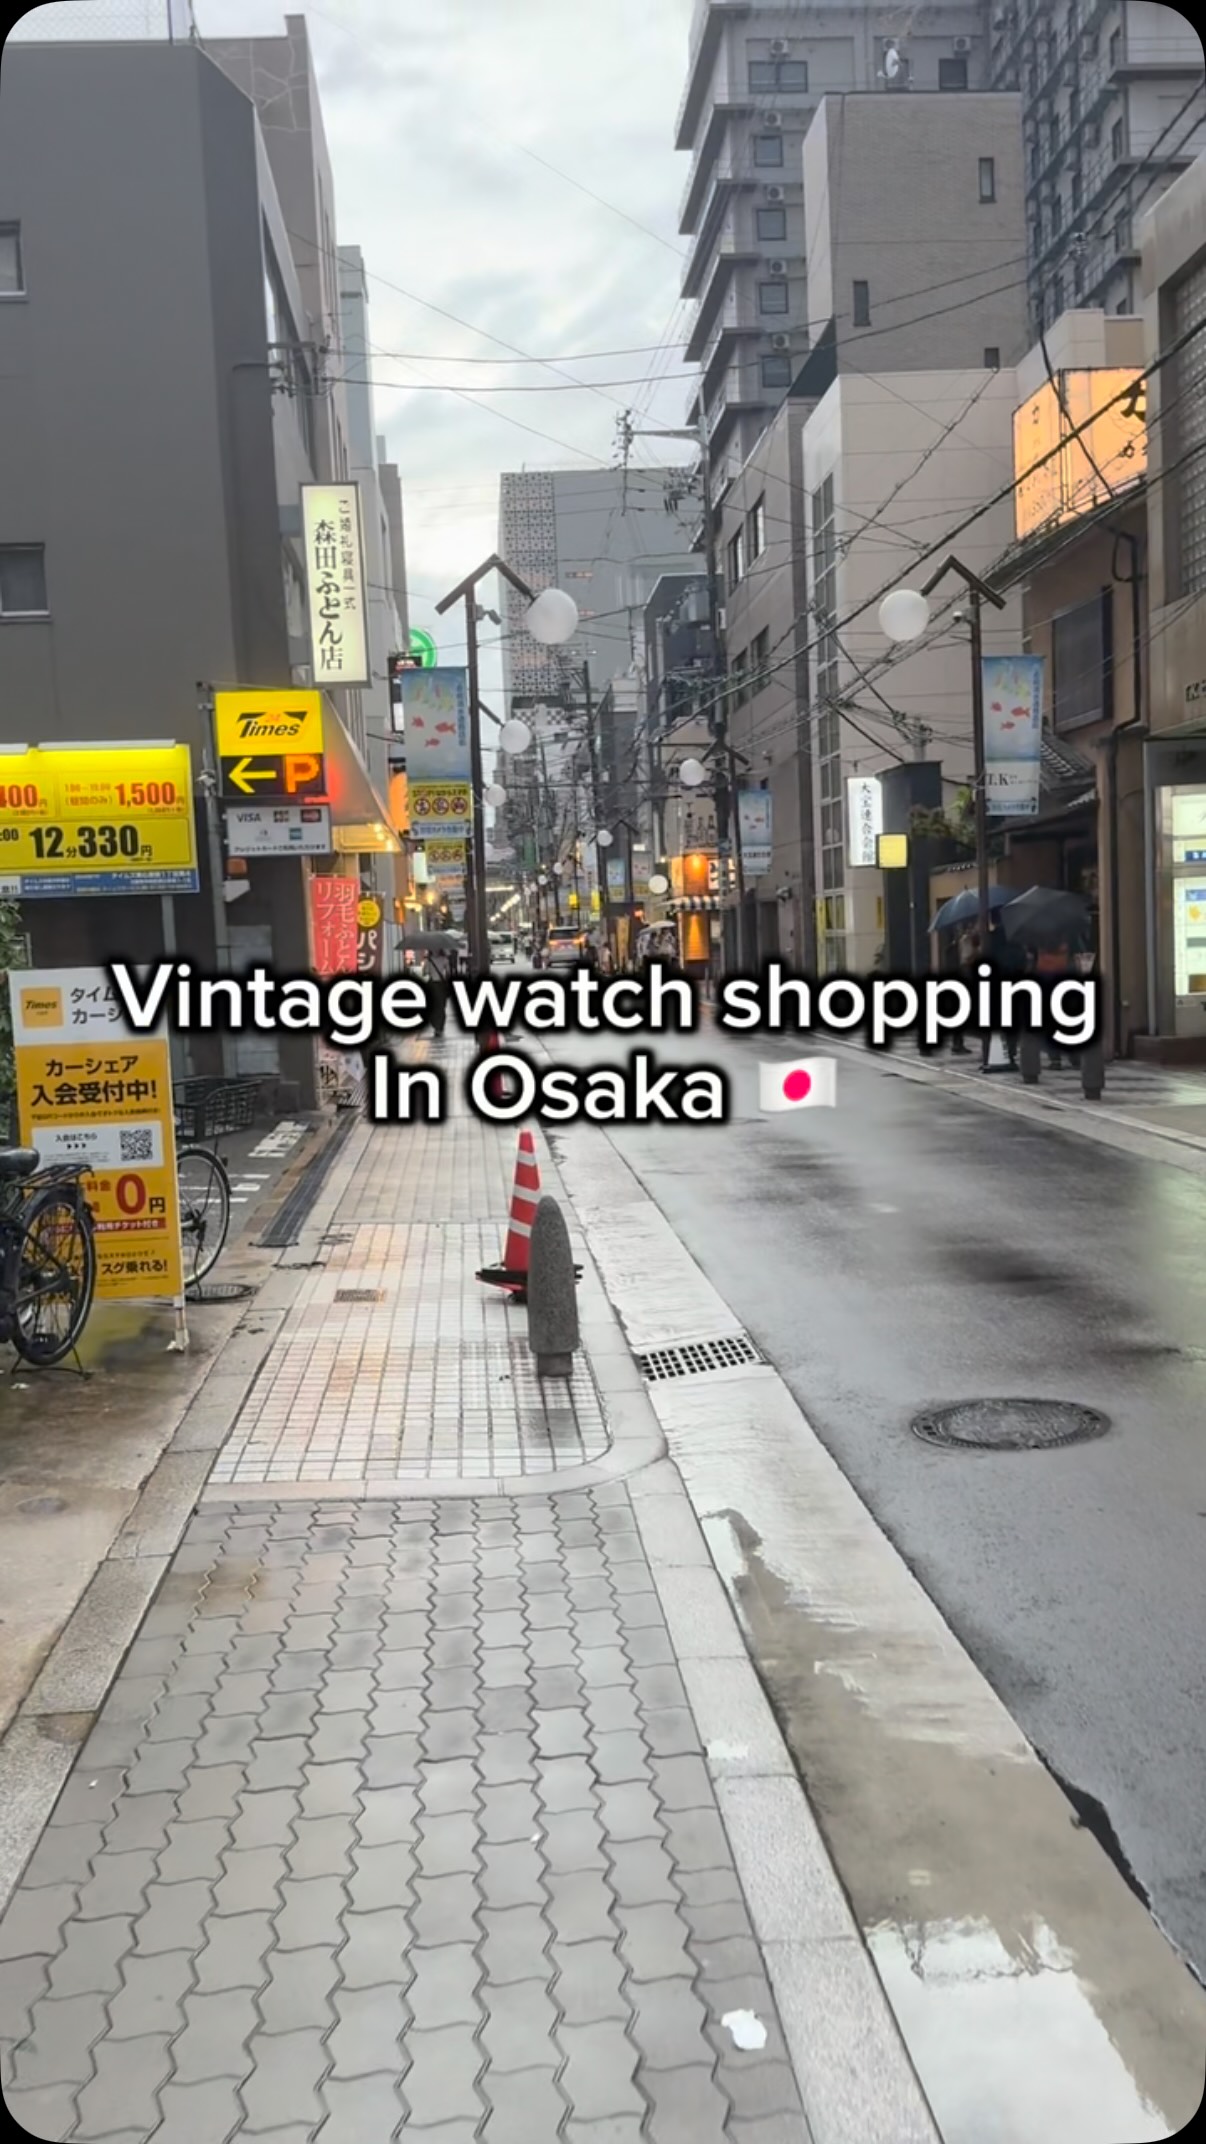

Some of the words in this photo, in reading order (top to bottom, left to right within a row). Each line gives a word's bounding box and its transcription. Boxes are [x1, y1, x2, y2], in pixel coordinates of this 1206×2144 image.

[314, 518, 343, 671] 森田ふとん店
[237, 712, 303, 739] Times
[285, 753, 320, 793] P
[236, 812, 262, 823] VISA
[316, 882, 335, 976] リフォーム
[335, 882, 355, 975] 羽毛ふとん
[25, 1000, 57, 1011] Times
[45, 1055, 139, 1078] カーシェア
[30, 1079, 157, 1107] 入会受付中!
[115, 1173, 166, 1216] 0円
[101, 1259, 168, 1276] スグ乗れる!
